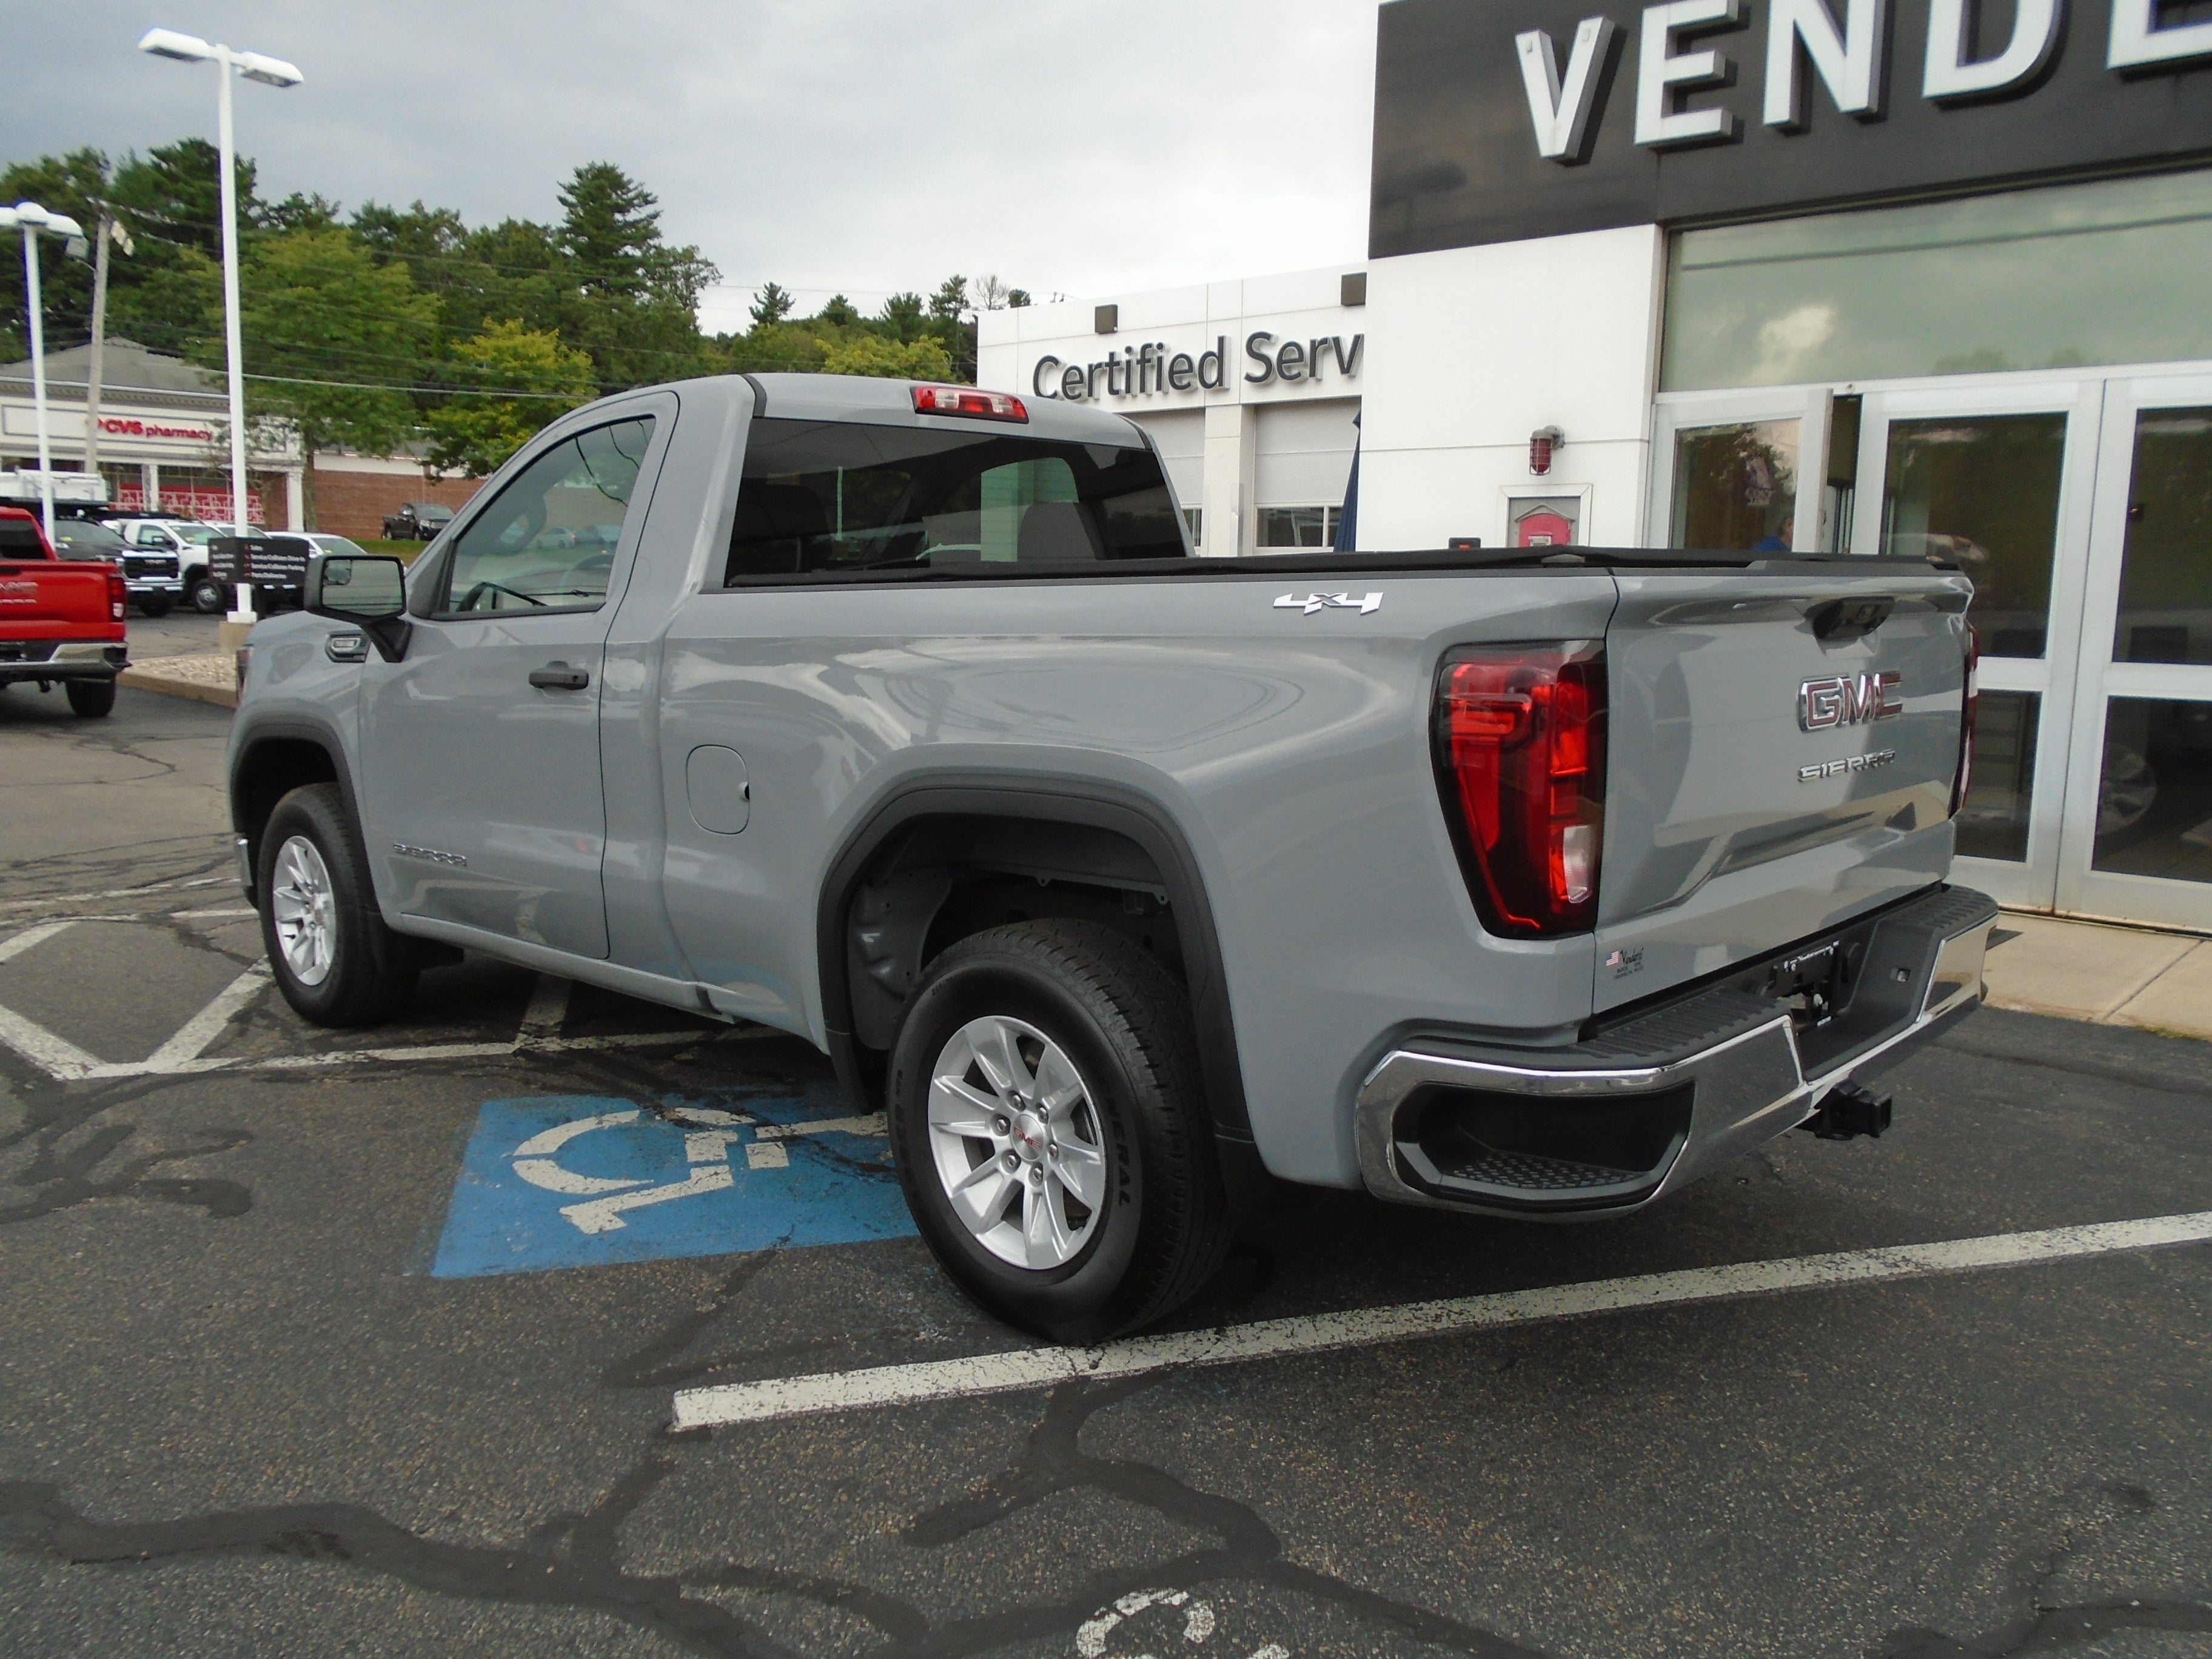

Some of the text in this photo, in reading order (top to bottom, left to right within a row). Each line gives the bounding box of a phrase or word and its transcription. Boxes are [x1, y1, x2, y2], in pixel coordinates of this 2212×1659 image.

[1032, 332, 1364, 400] Certified Serv
[105, 418, 213, 441] CVS pharmacy
[1797, 669, 1904, 734] GMC
[1797, 748, 1896, 782] SIERRA
[1014, 1125, 1041, 1150] GMC
